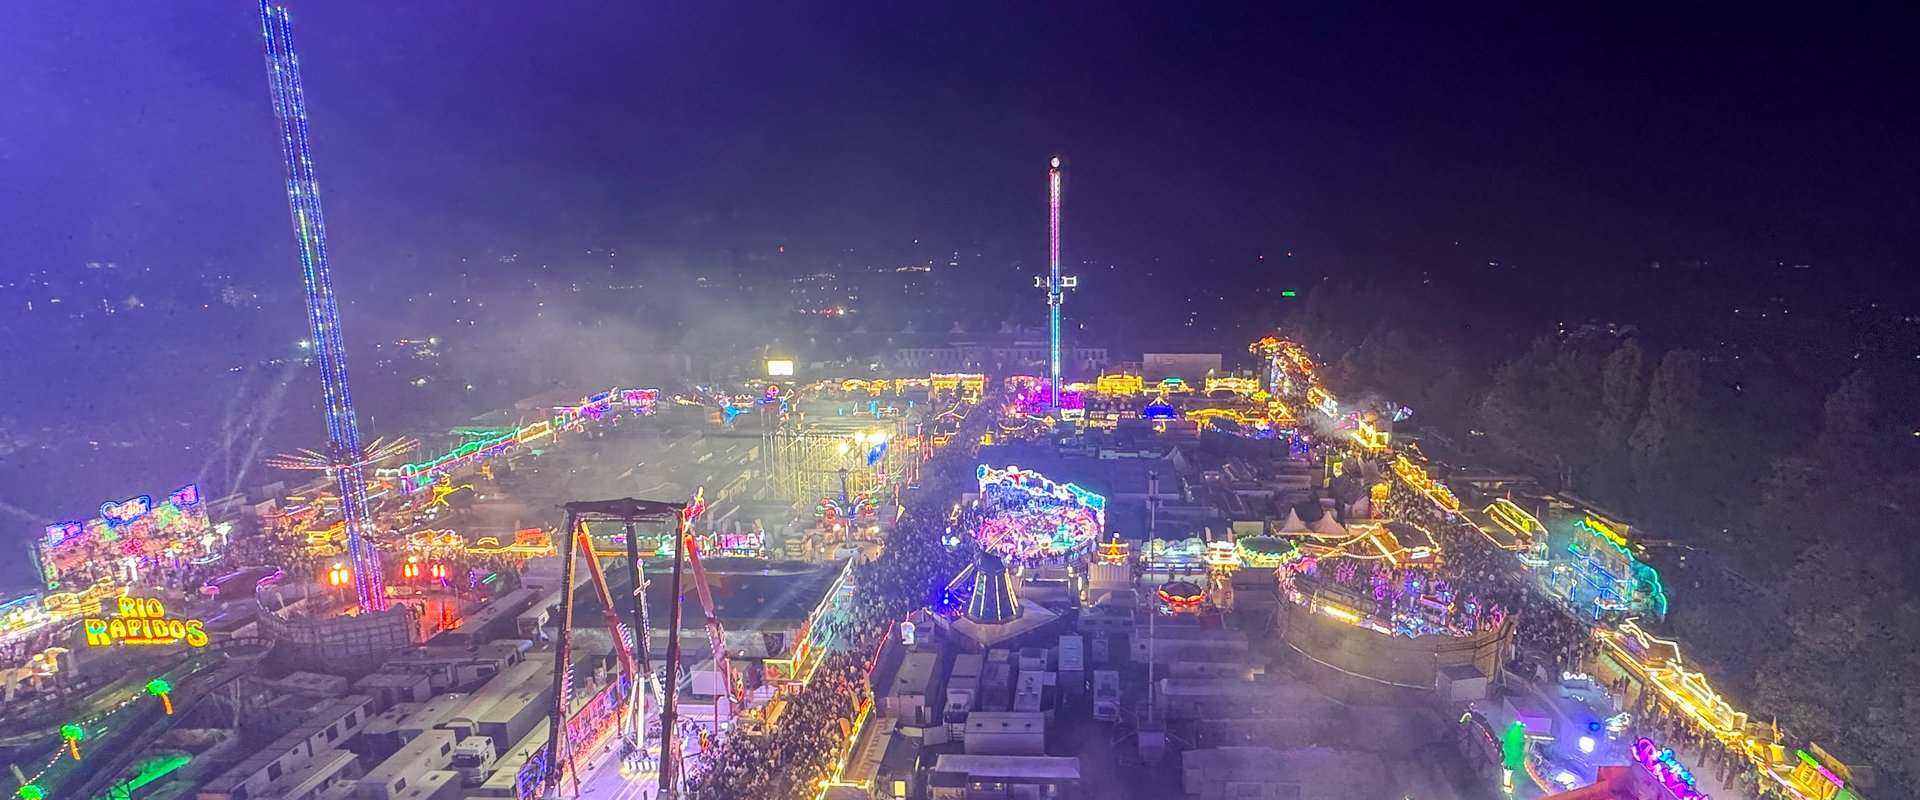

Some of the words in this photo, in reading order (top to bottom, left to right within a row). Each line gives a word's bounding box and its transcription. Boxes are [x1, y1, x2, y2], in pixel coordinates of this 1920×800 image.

[119, 597, 164, 618] RIO
[84, 619, 209, 647] RAPIDOS
[1656, 747, 1696, 786] Super
